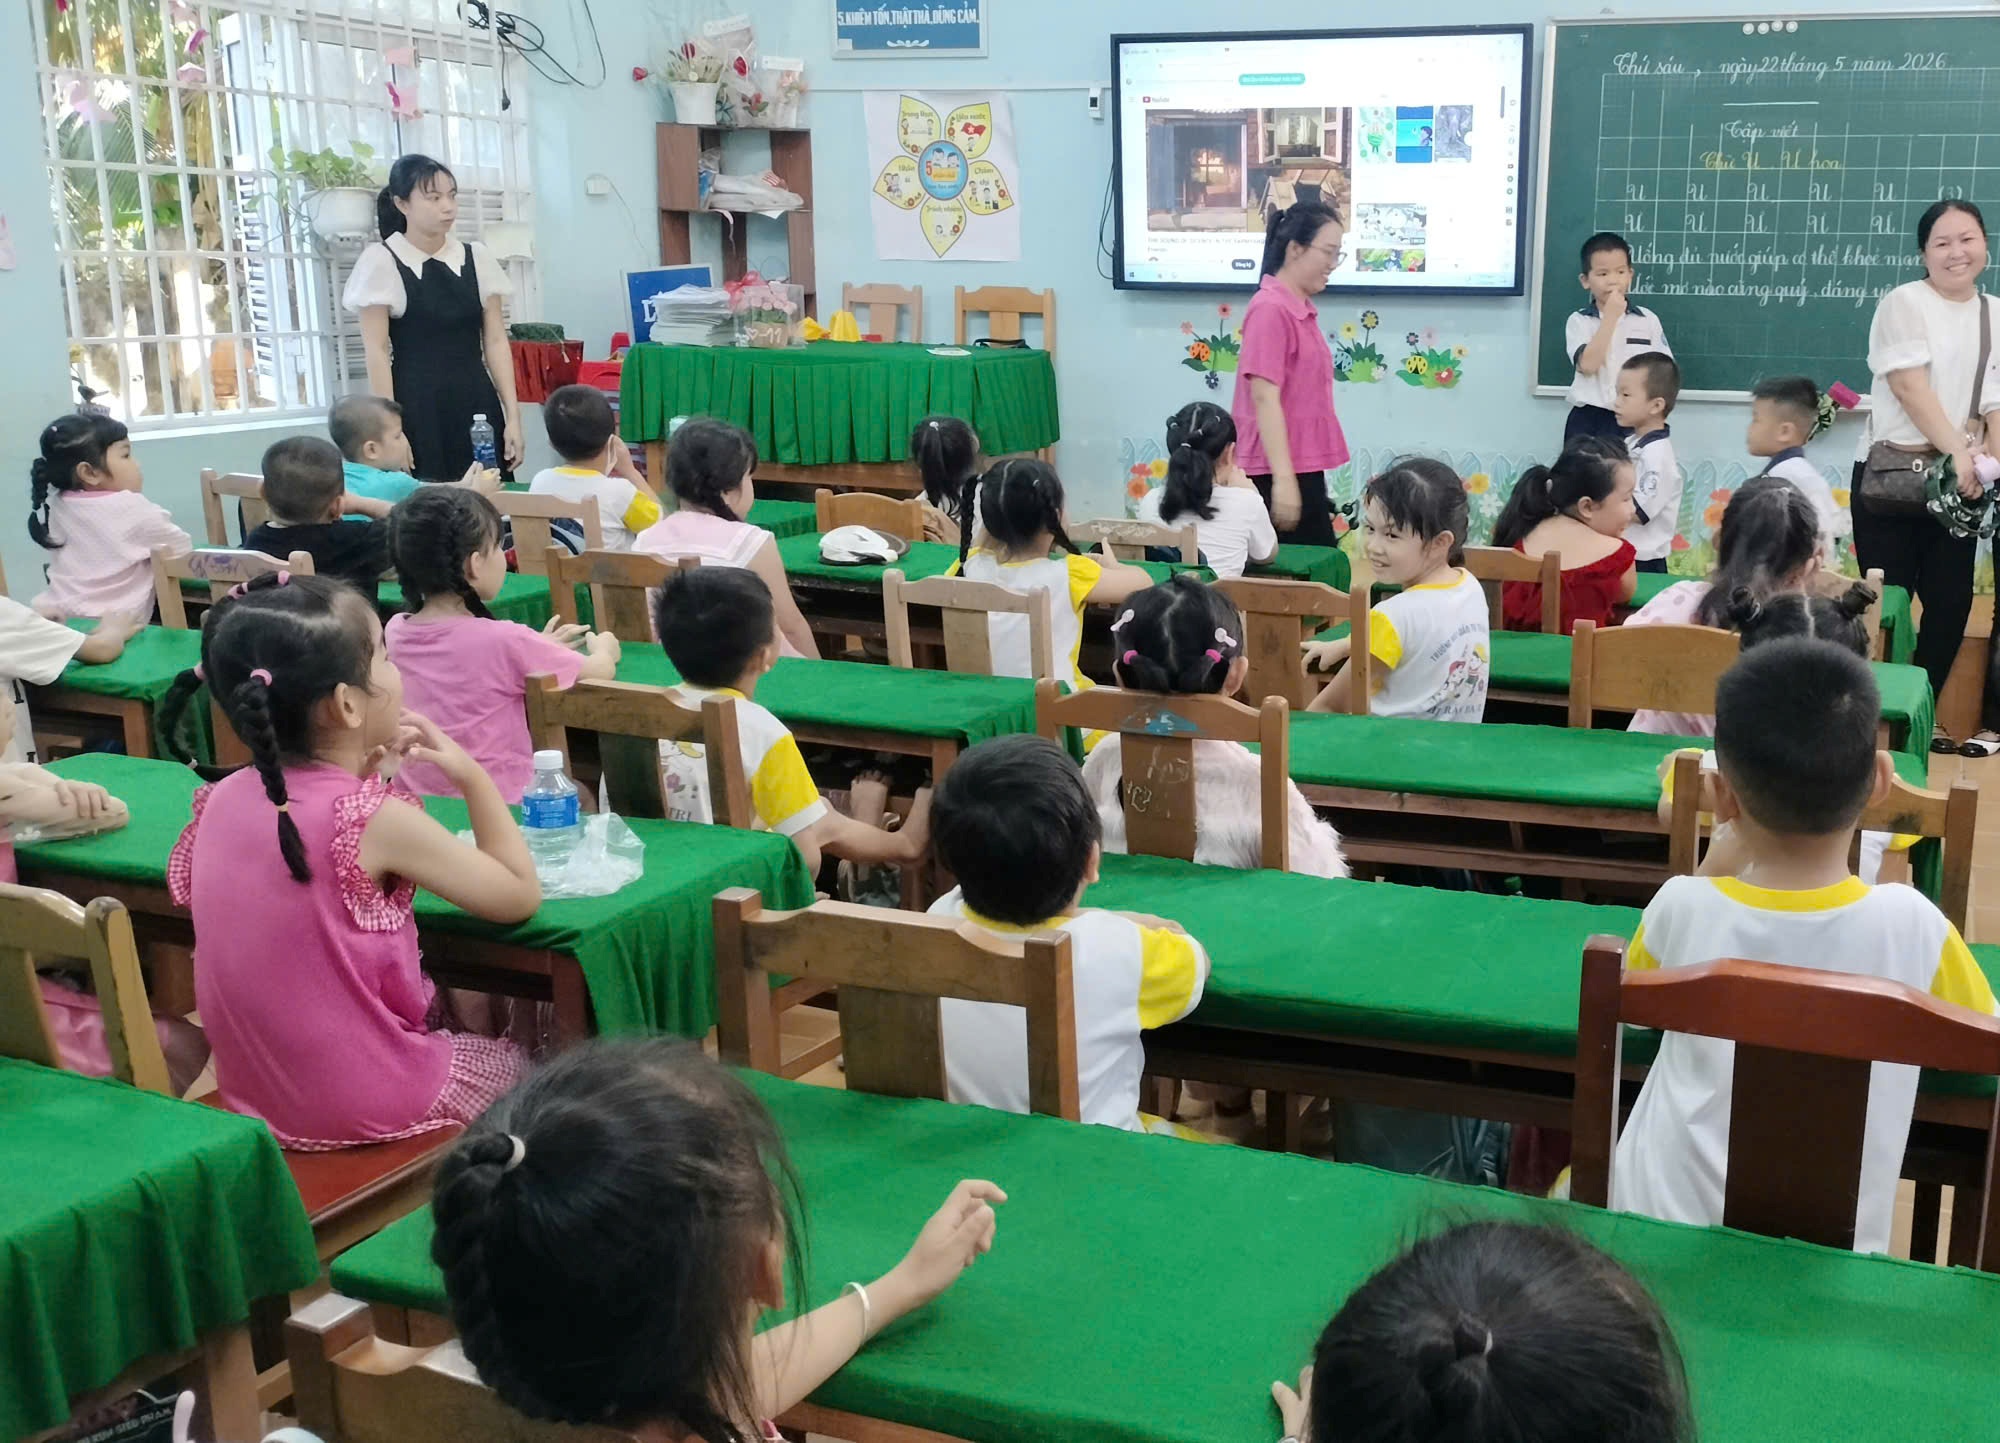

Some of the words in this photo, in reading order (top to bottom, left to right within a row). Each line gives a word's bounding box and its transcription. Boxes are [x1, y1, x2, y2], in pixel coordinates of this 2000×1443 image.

[1613, 51, 1650, 75] Thứ
[1719, 57, 1758, 84] ngày
[1757, 56, 1780, 73] 22
[1780, 51, 1828, 82] tháng
[1833, 56, 1847, 72] 5
[1852, 57, 1894, 72] năm
[1899, 52, 1948, 71] 2026
[1748, 246, 1789, 275] giúp
